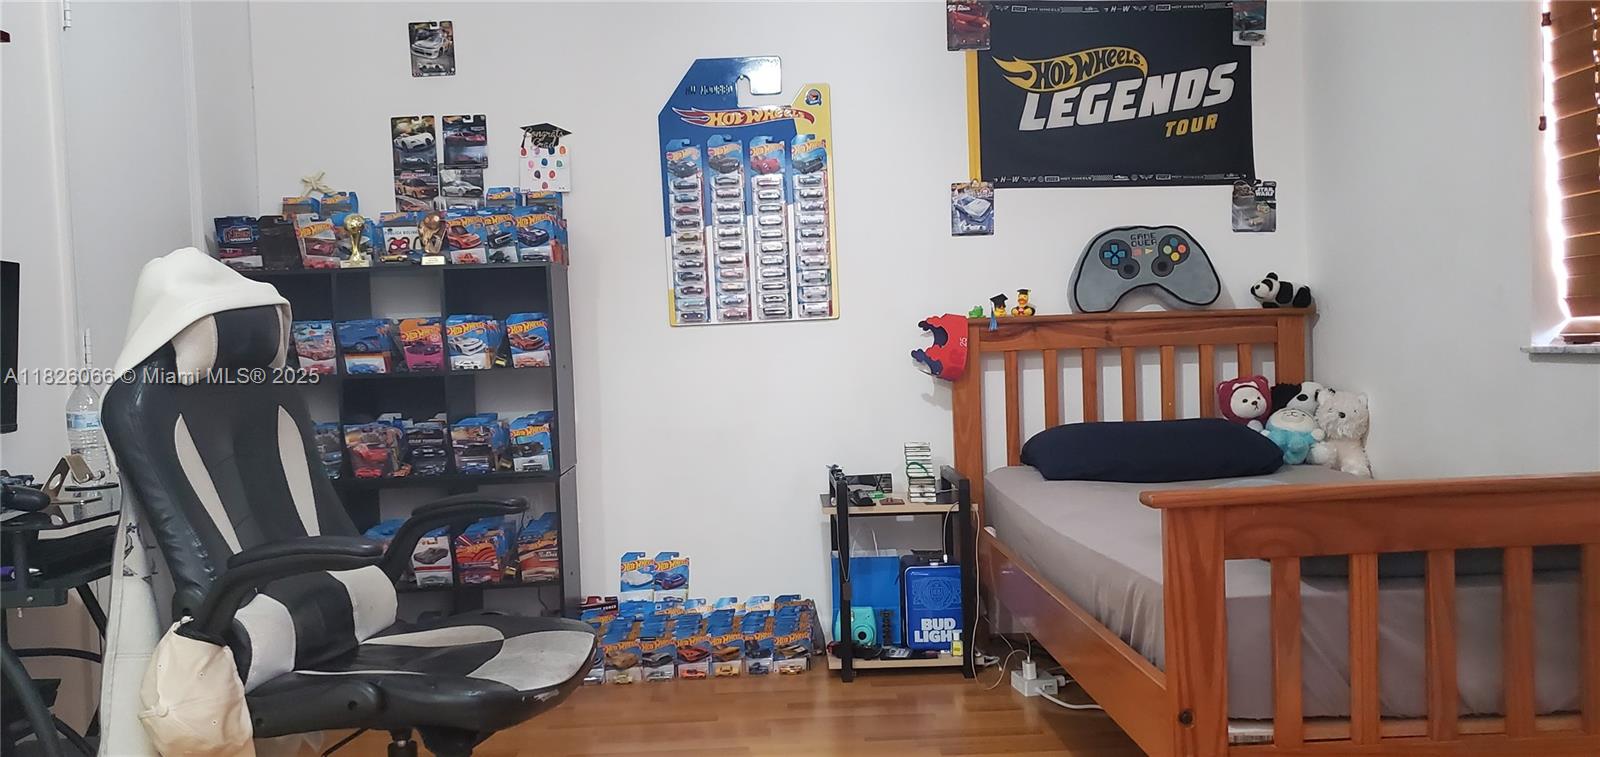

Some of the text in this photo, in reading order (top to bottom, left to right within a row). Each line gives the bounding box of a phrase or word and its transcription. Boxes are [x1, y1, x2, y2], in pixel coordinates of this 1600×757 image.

[1030, 59, 1074, 89] HOT
[1019, 61, 1238, 131] LEGENDS
[708, 111, 745, 126] HOT
[1165, 113, 1219, 137] TOUR
[1130, 232, 1157, 241] GAME
[1131, 239, 1158, 247] OVER
[921, 618, 956, 631] BUD
[914, 629, 962, 643] LIGHT
